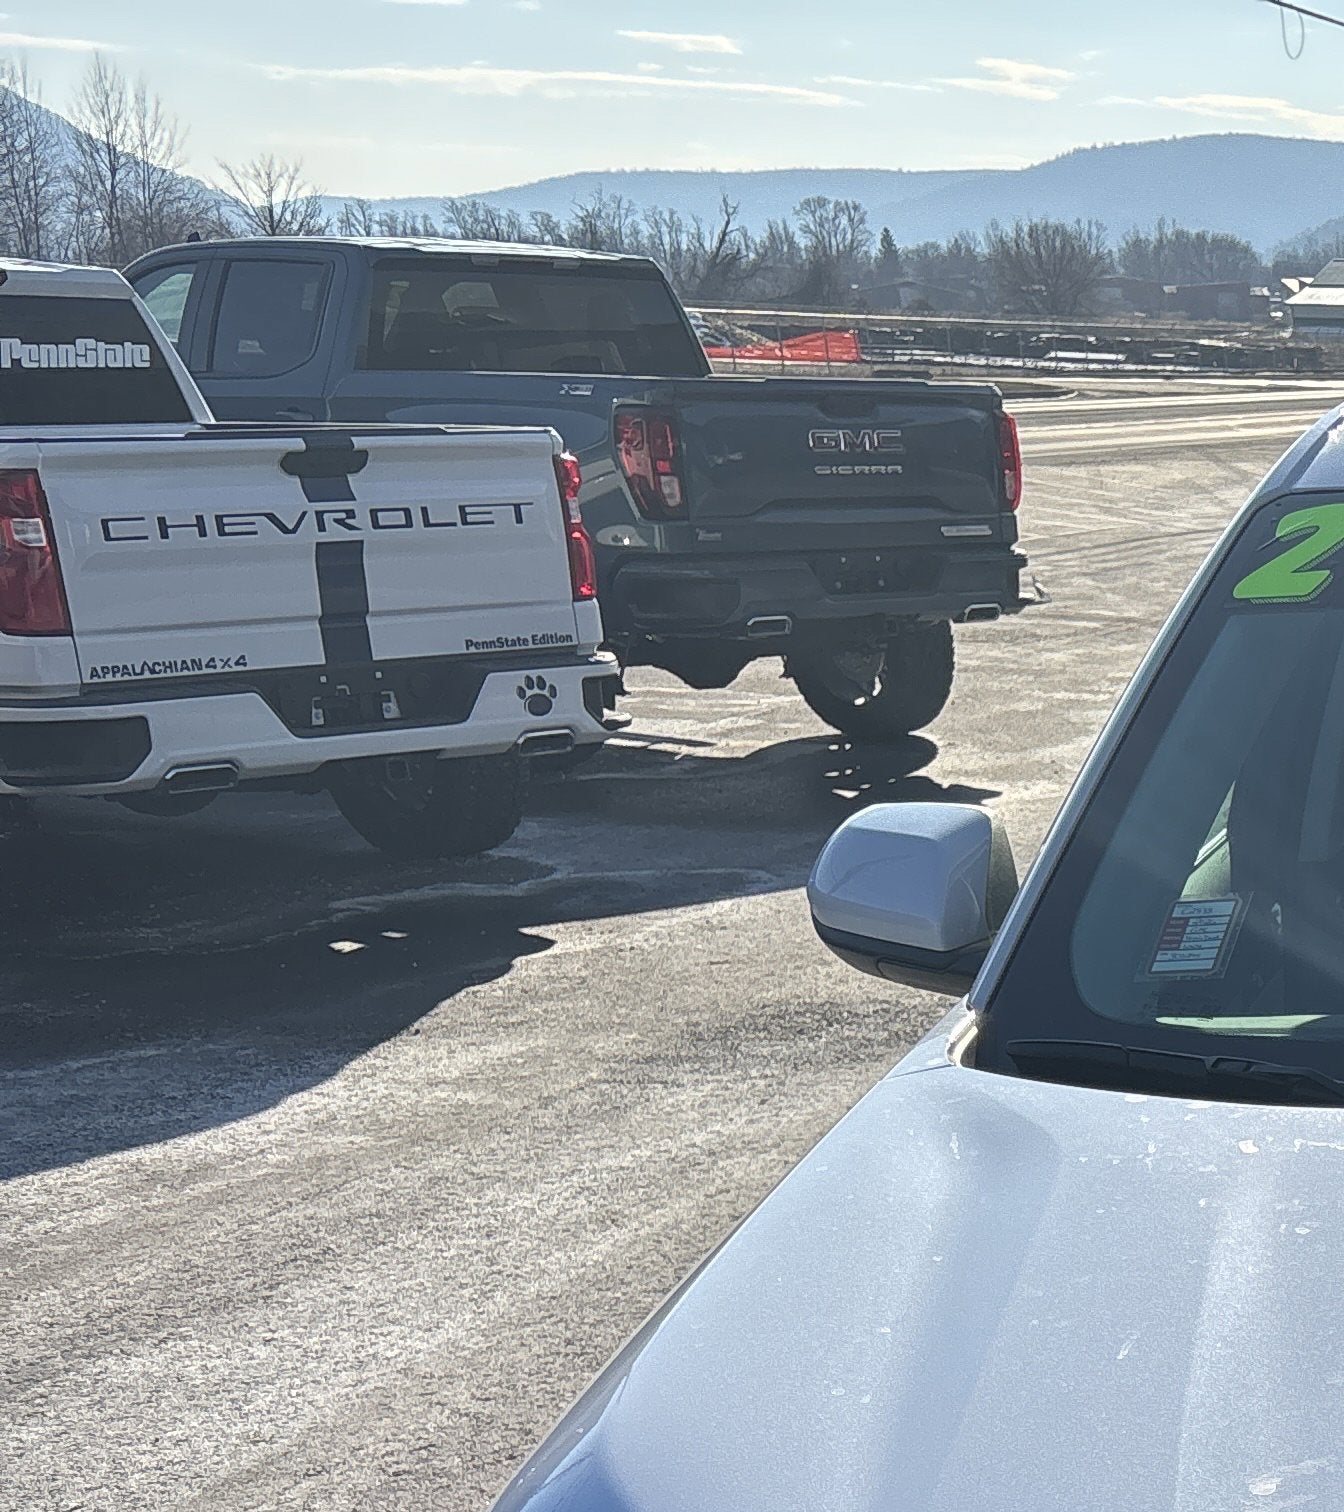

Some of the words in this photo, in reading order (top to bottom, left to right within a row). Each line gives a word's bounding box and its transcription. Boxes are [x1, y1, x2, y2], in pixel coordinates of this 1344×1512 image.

[0, 337, 150, 368] PennState
[808, 429, 902, 452] GMC
[814, 465, 903, 475] SIERRA
[101, 502, 535, 542] CHEVROLET
[465, 636, 529, 651] PennState
[531, 632, 573, 646] Edition
